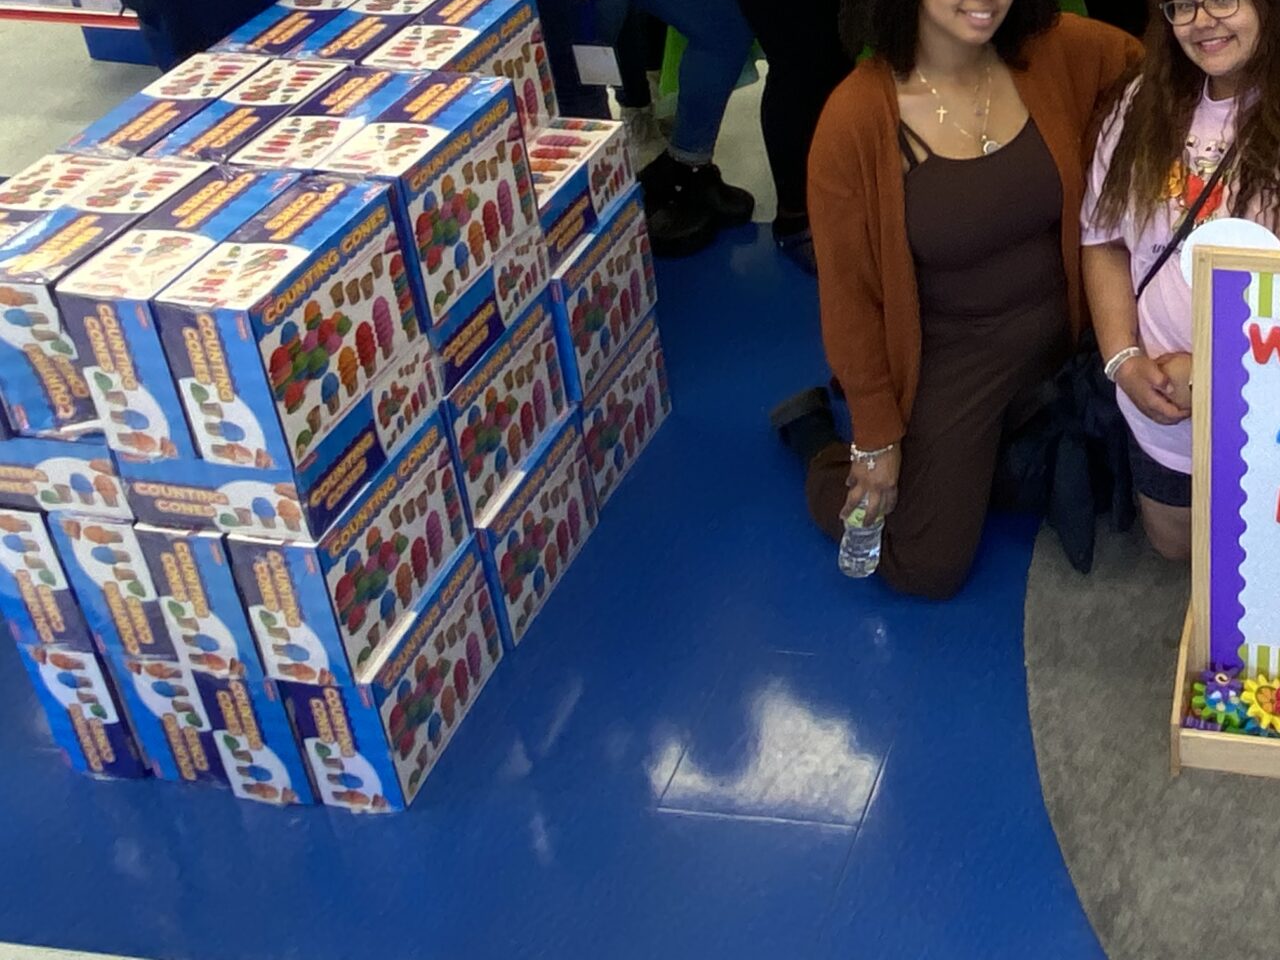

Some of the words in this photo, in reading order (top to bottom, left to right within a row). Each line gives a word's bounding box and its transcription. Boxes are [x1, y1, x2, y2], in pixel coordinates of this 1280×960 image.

[410, 132, 471, 189] COUNTING
[472, 99, 509, 137] CONES
[171, 180, 226, 217] CONES
[176, 172, 256, 228] COUNTING
[264, 192, 319, 230] CONES
[269, 182, 346, 240] COUNTING
[262, 249, 340, 325] COUNTING
[341, 205, 388, 254] CONES
[84, 316, 114, 372] CONES
[97, 304, 138, 391] COUNTING
[182, 327, 211, 385] CONES
[197, 313, 235, 402] COUNTING
[443, 300, 495, 360] COUNTING
[454, 324, 489, 368] CONES
[457, 343, 511, 407] COUNTING
[512, 304, 544, 345] CONES
[132, 482, 229, 505] COUNTING
[309, 431, 375, 507] COUNTING
[325, 457, 367, 511] CONES
[329, 475, 397, 557] COUNTING
[398, 425, 439, 477] CONES
[154, 499, 216, 517] CONES
[496, 467, 545, 535] COUNTING
[161, 552, 188, 602] CONES
[174, 541, 209, 618] COUNTING
[252, 561, 280, 612] CONES
[266, 550, 301, 628] COUNTING
[103, 581, 141, 655] COUNTING
[126, 595, 154, 645] CONES
[384, 605, 441, 689] COUNTING
[442, 552, 475, 603] CONES
[216, 690, 243, 736] CONES
[228, 680, 263, 751] COUNTING
[310, 698, 336, 744] CONES
[323, 687, 356, 758] COUNTING
